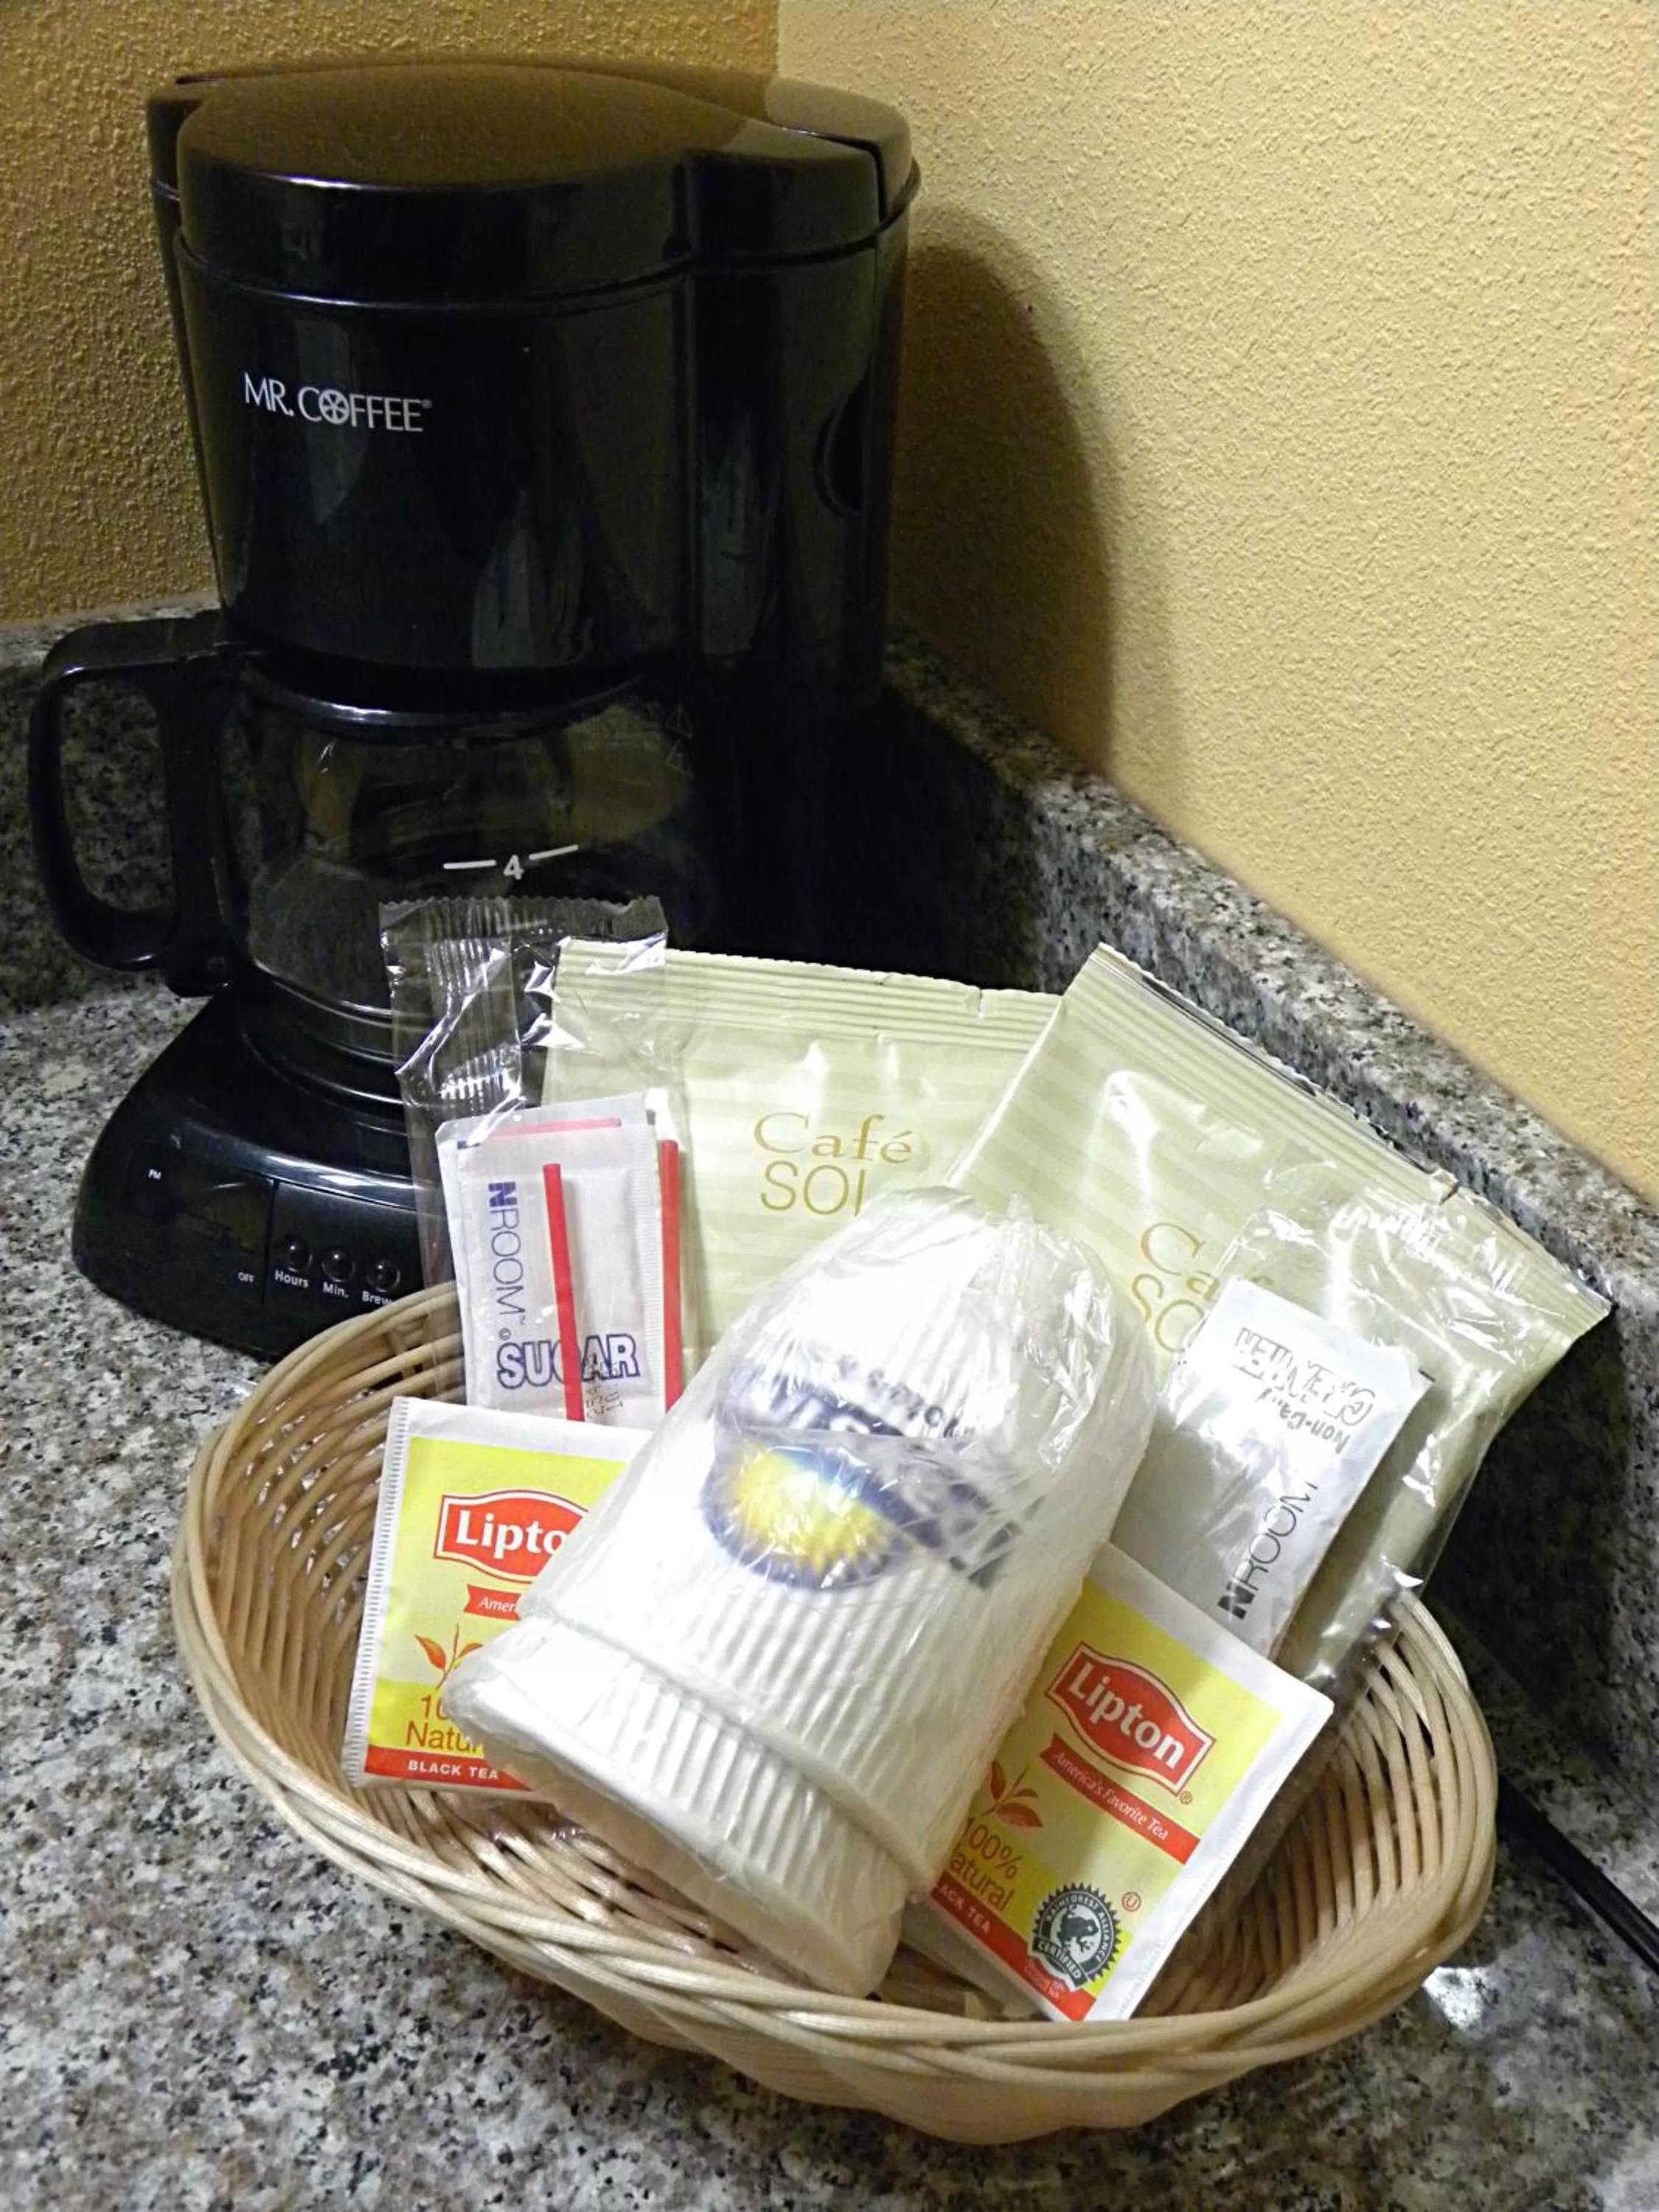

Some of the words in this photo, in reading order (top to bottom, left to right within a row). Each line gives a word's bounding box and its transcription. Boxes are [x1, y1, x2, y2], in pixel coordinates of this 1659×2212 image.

[244, 372, 294, 417] MR.
[297, 386, 424, 431] COFFEE
[503, 855, 525, 880] 4
[754, 1111, 913, 1164] Café
[488, 1182, 526, 1316] NROOM
[274, 1269, 309, 1288] Hours
[323, 1281, 349, 1298] Min.
[456, 1509, 567, 1559] Lipto
[1068, 1662, 1185, 1770] Lipton
[408, 1760, 462, 1776] BLACK
[468, 1767, 499, 1780] TEA
[1054, 1751, 1104, 1795] America's
[1102, 1788, 1147, 1824] Favorite
[1147, 1817, 1169, 1840] Tea
[962, 1817, 1023, 1879] 100%
[950, 1843, 1015, 1912] atural
[1037, 1941, 1082, 1979] CERTIFIED
